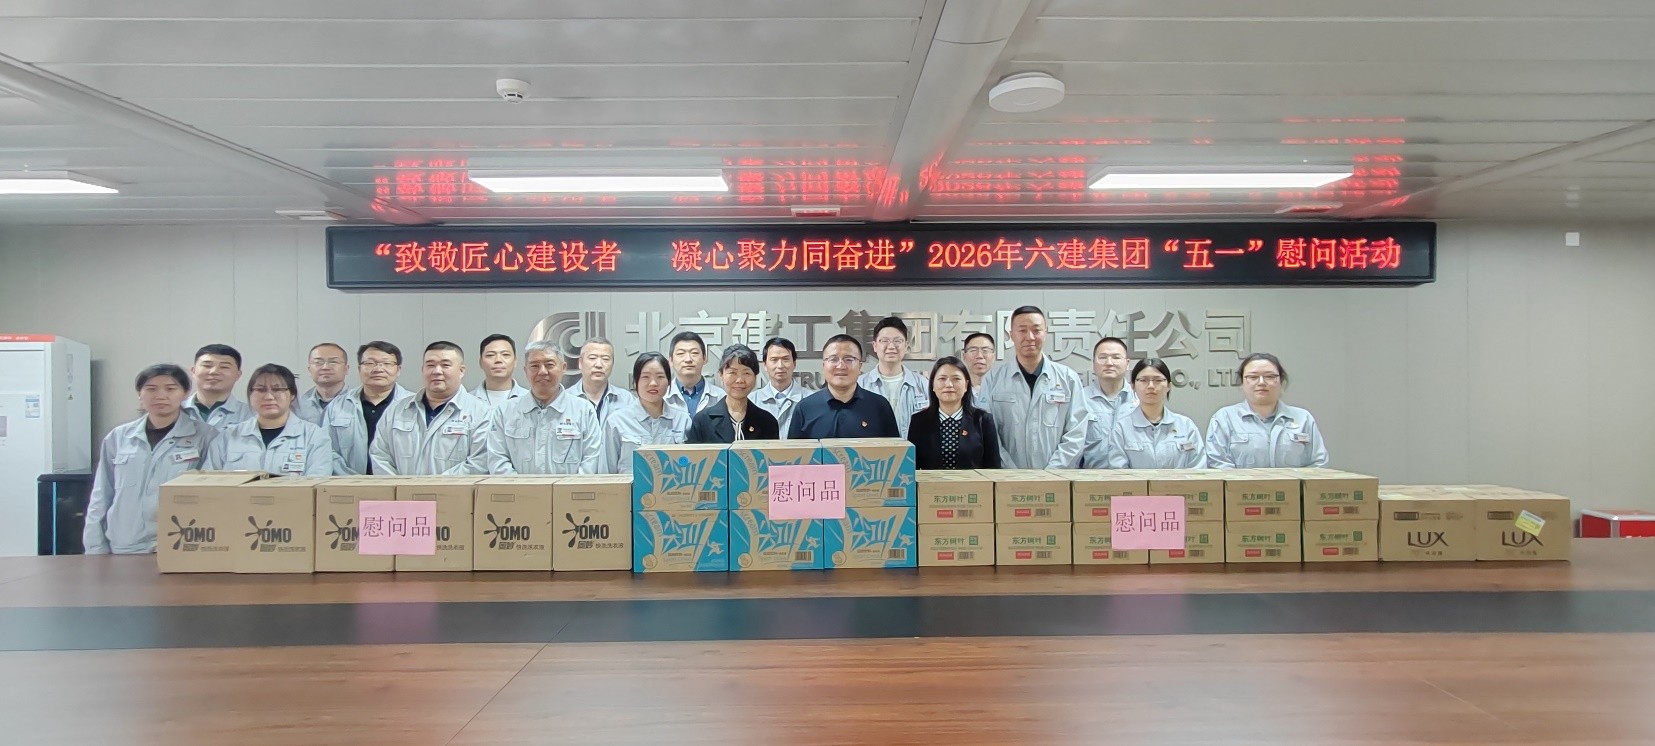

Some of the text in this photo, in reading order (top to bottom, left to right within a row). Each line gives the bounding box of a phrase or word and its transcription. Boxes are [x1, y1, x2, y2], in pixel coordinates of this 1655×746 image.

[772, 480, 840, 503] 慰问品
[362, 515, 431, 538] 慰问品
[1115, 511, 1180, 533] 慰问品
[184, 527, 216, 543] OMO
[261, 527, 292, 543] OMO
[500, 525, 531, 541] OMO
[578, 524, 610, 540] OMO
[1407, 531, 1449, 548] LUX
[1501, 530, 1544, 547] LUX
